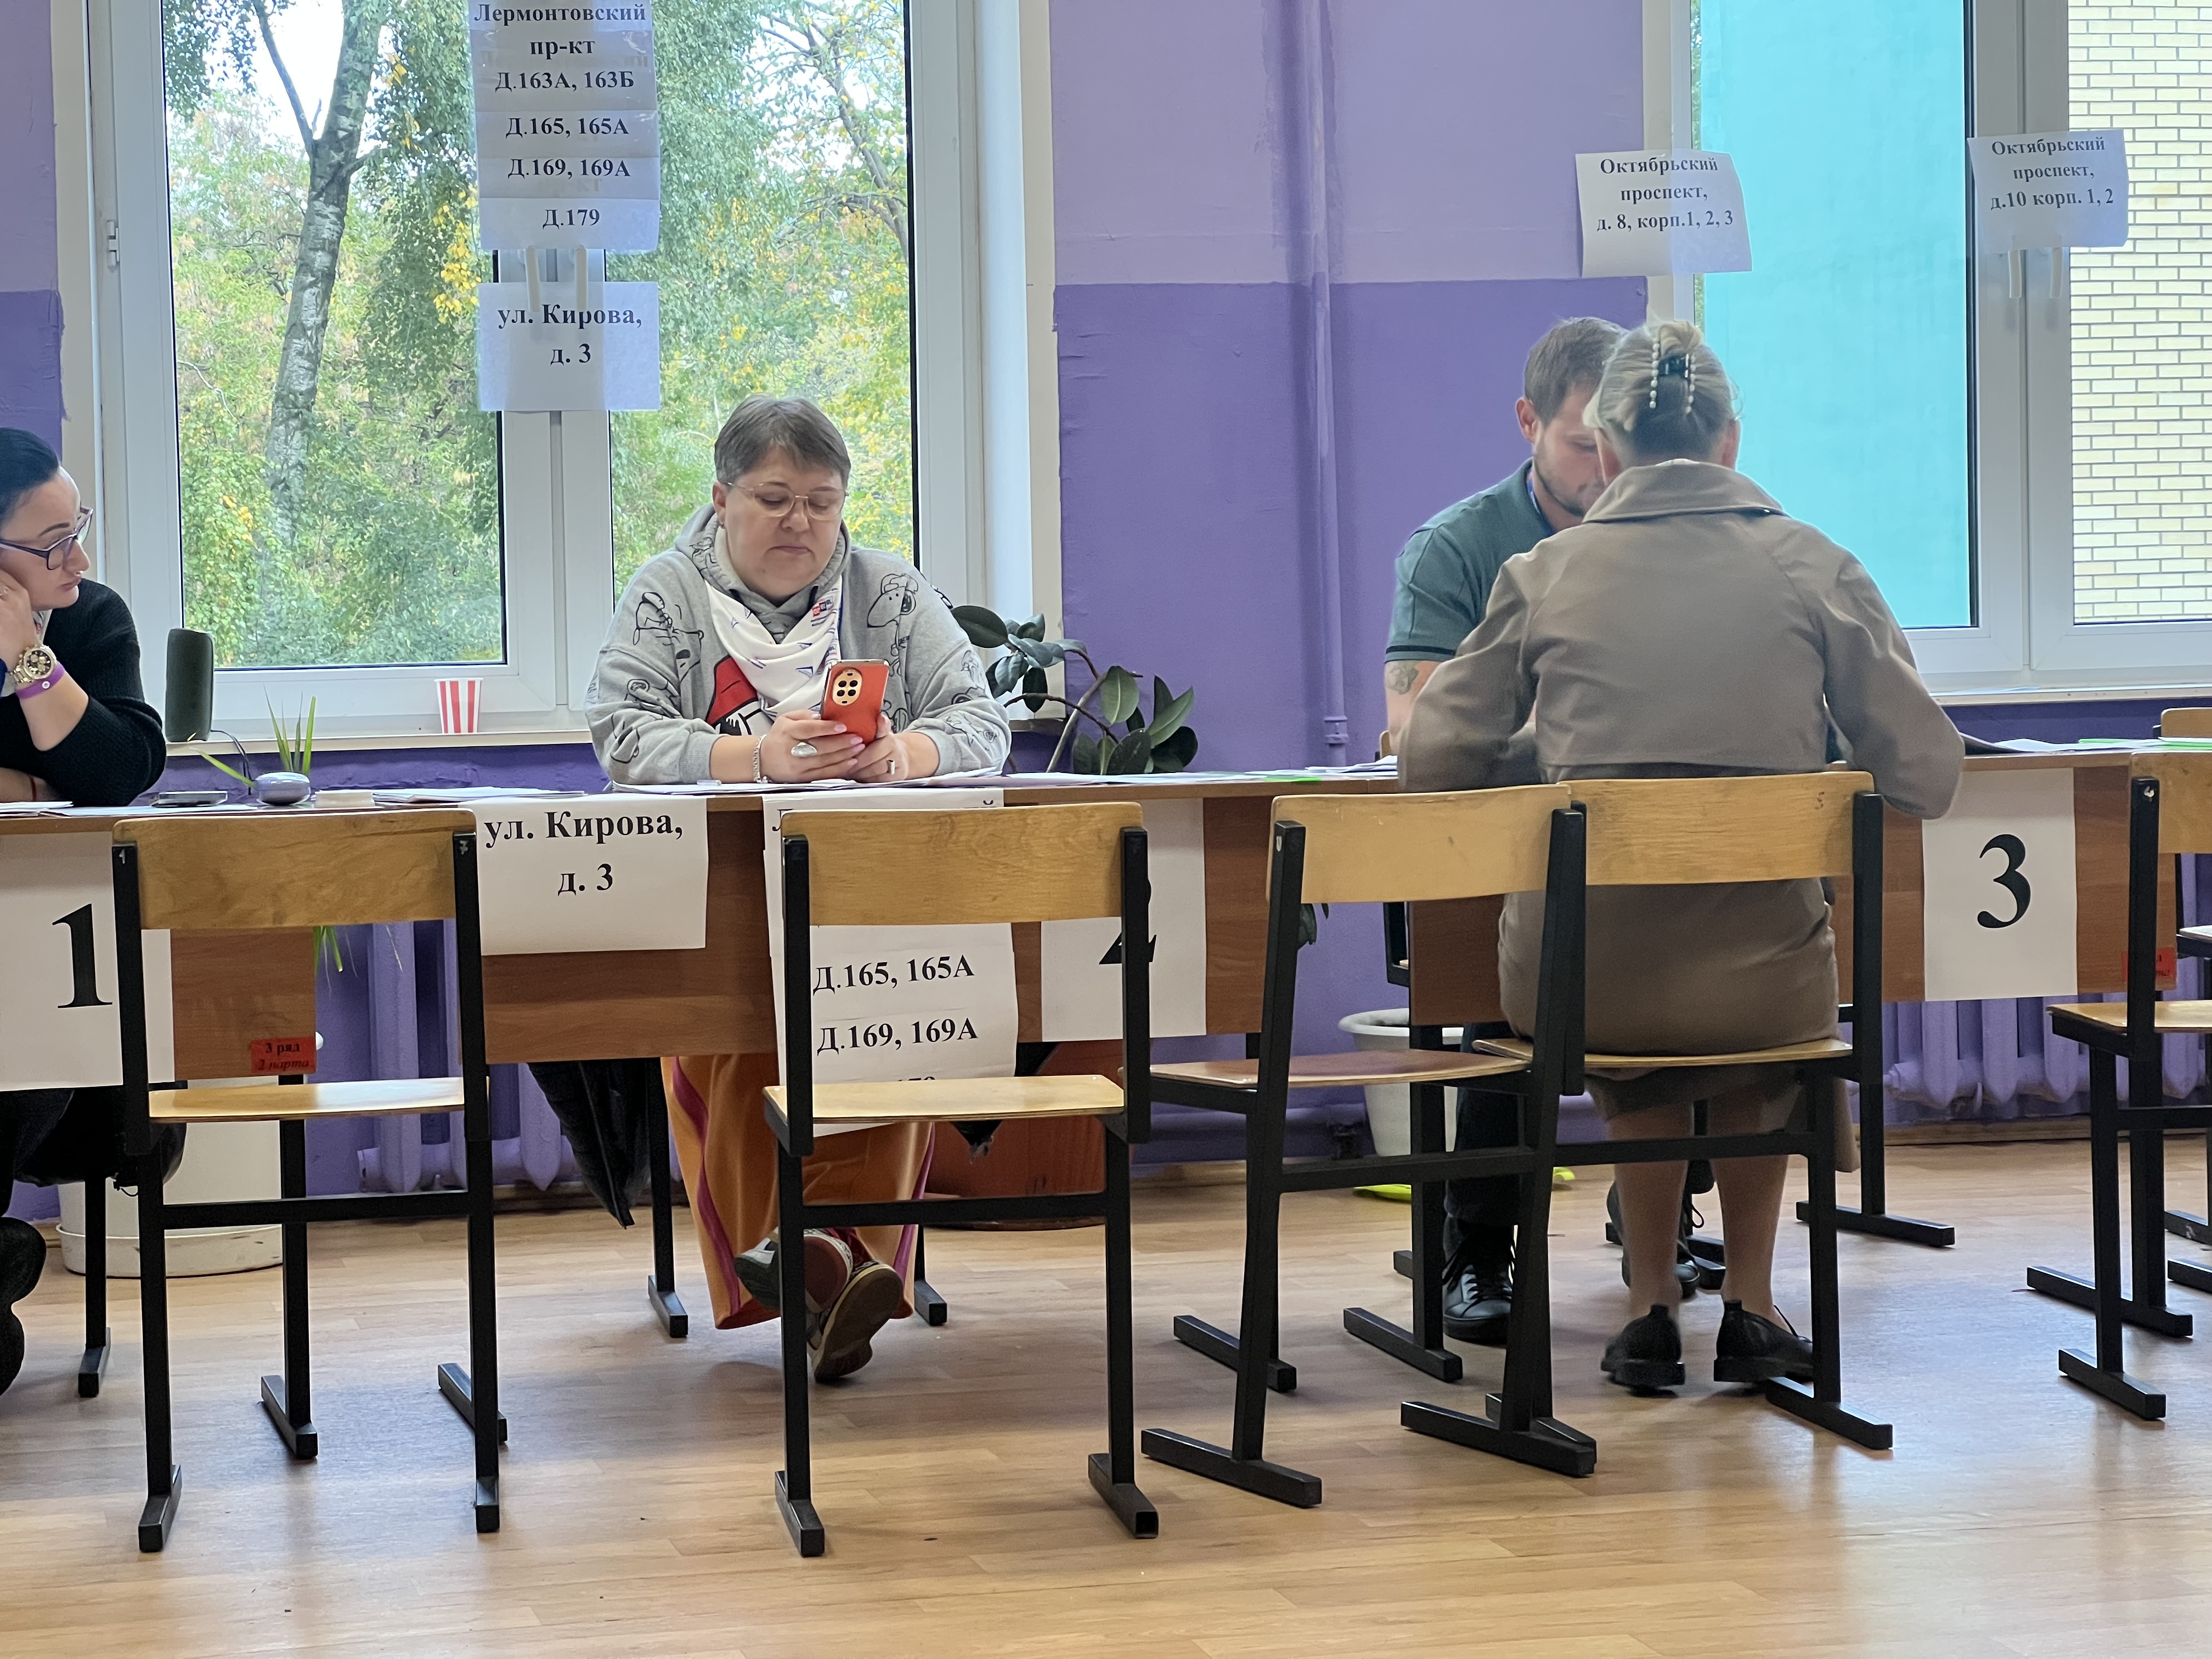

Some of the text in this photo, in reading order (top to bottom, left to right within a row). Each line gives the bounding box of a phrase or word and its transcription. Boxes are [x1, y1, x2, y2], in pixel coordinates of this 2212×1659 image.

[474, 4, 646, 26] Лермонтовский
[530, 41, 595, 60] пр-кт
[495, 71, 634, 92] Д.163А, 163Б
[505, 117, 629, 138] Д.165, 165А
[1991, 137, 2105, 156] Октябрьский
[507, 159, 631, 179] Д.169, 169А
[1600, 157, 1718, 176] Октябрьский
[2013, 166, 2094, 183] проспект,
[1621, 187, 1707, 205] проспект,
[1990, 188, 2114, 211] д.10 корп. 1, 2
[542, 209, 600, 230] Д.179
[1596, 210, 1733, 232] д. 8, корп.1, 2, 3
[498, 304, 641, 330] ул. Кирова,
[550, 343, 591, 365] д. 3
[483, 811, 682, 849] ул. Кирова,
[557, 863, 613, 896] д. 3
[1977, 834, 2031, 929] 3
[51, 902, 114, 1009] 1
[812, 955, 975, 996] Д.165, 165А
[817, 1018, 978, 1057] Д.169, 169А
[276, 1043, 300, 1056] ряд
